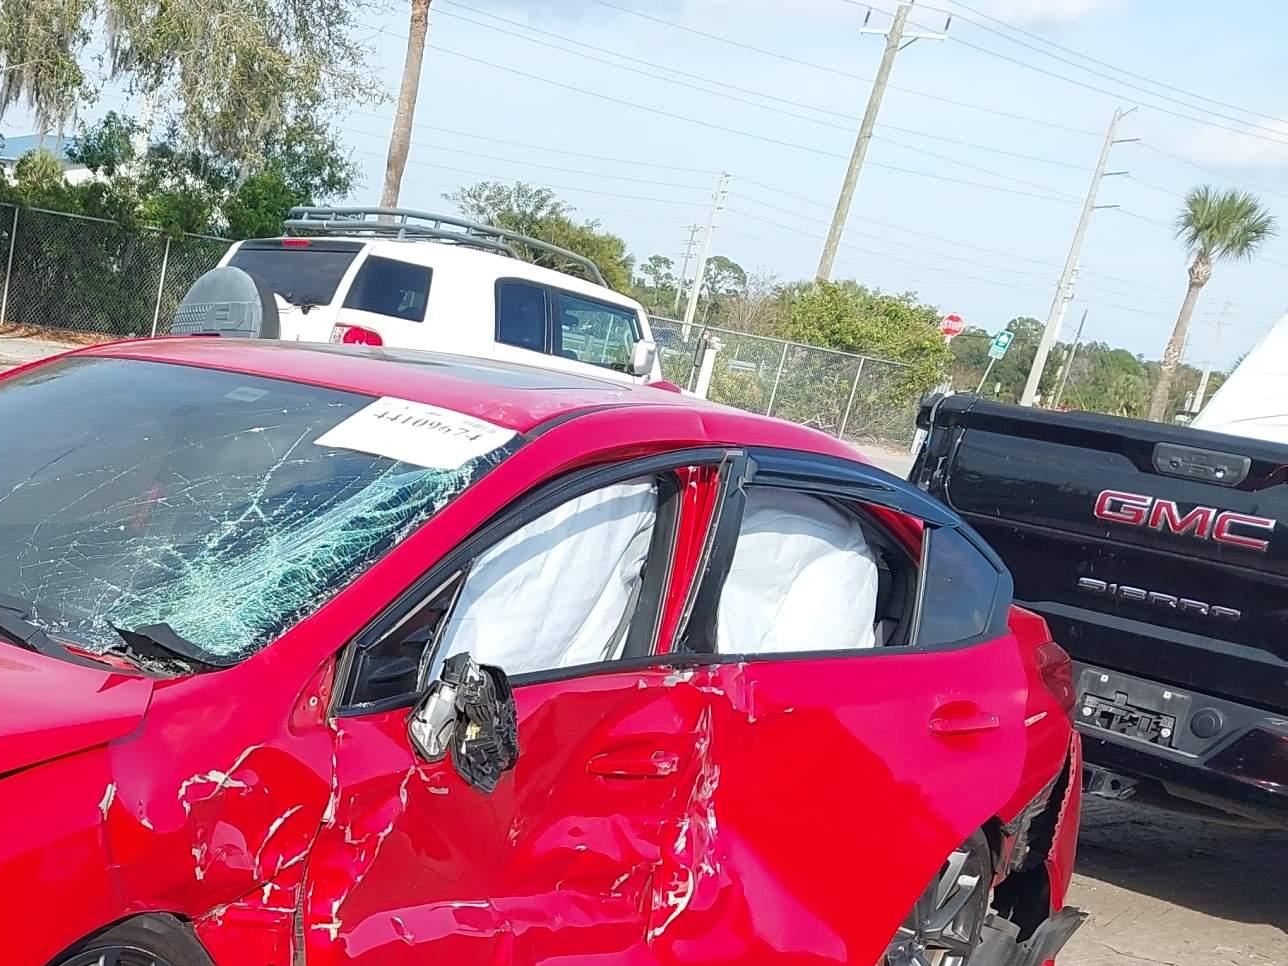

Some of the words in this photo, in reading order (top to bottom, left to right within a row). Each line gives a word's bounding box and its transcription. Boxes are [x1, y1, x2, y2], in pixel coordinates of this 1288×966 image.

[942, 320, 963, 331] STOP
[373, 411, 483, 441] 44109674
[1094, 489, 1277, 552] GMC
[1077, 577, 1242, 622] SIERRA
